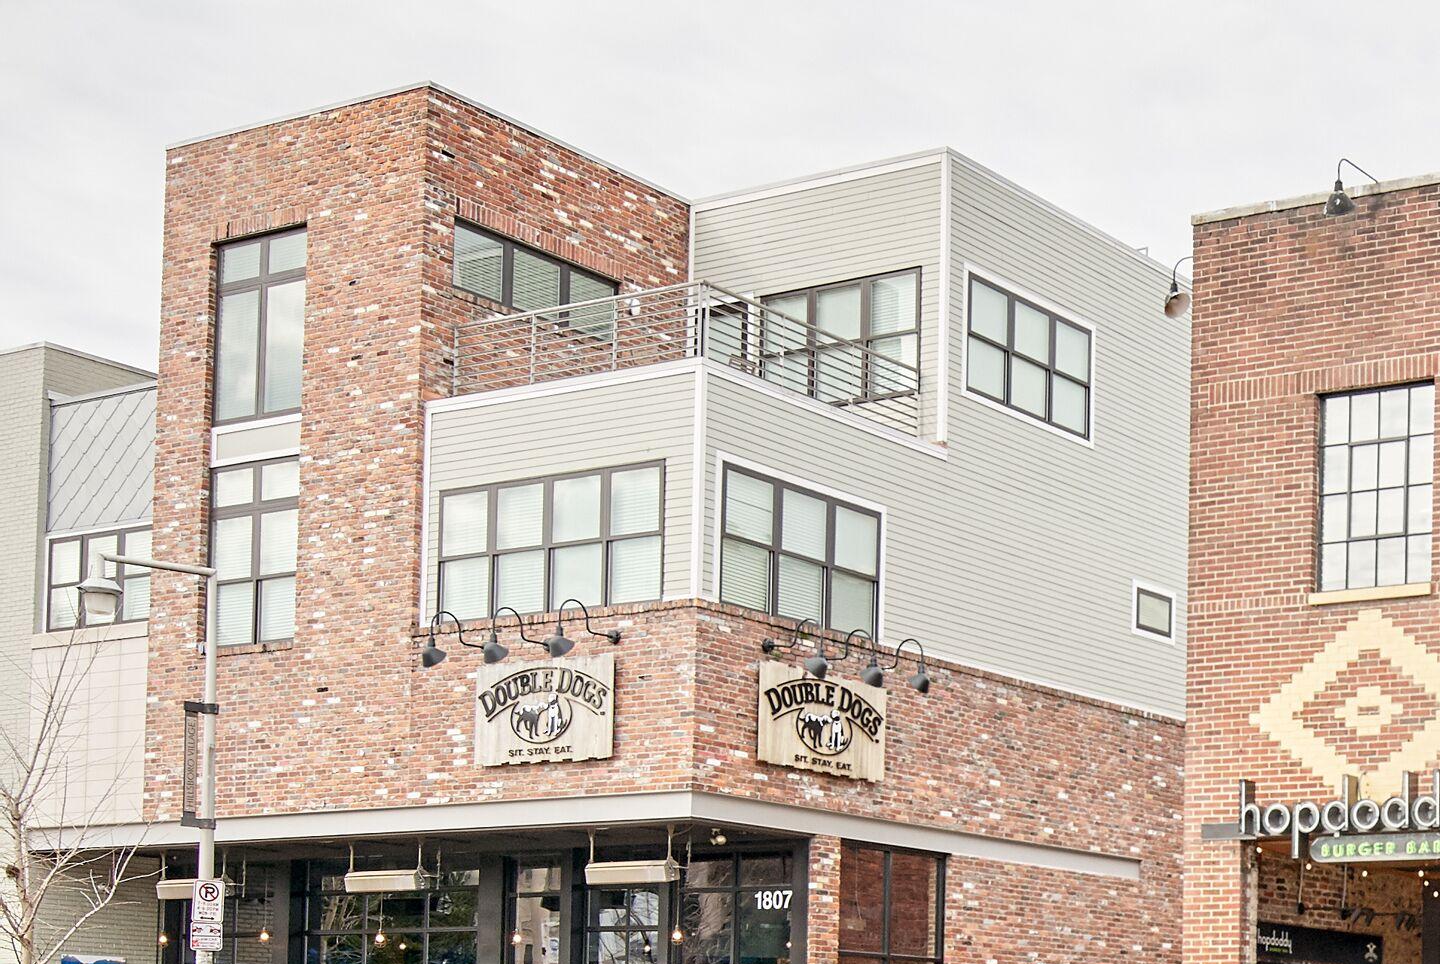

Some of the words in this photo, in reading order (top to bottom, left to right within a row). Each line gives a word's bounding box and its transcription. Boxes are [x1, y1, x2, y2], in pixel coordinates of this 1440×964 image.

[478, 670, 554, 718] DOUBLE
[556, 667, 607, 709] DOGS
[764, 682, 835, 715] DOUBLE
[838, 686, 881, 736] DOGS
[187, 722, 196, 756] VILLAGE
[1321, 841, 1396, 857] BURGER
[754, 890, 793, 910] 1807
[1257, 928, 1293, 954] hopdoddy
